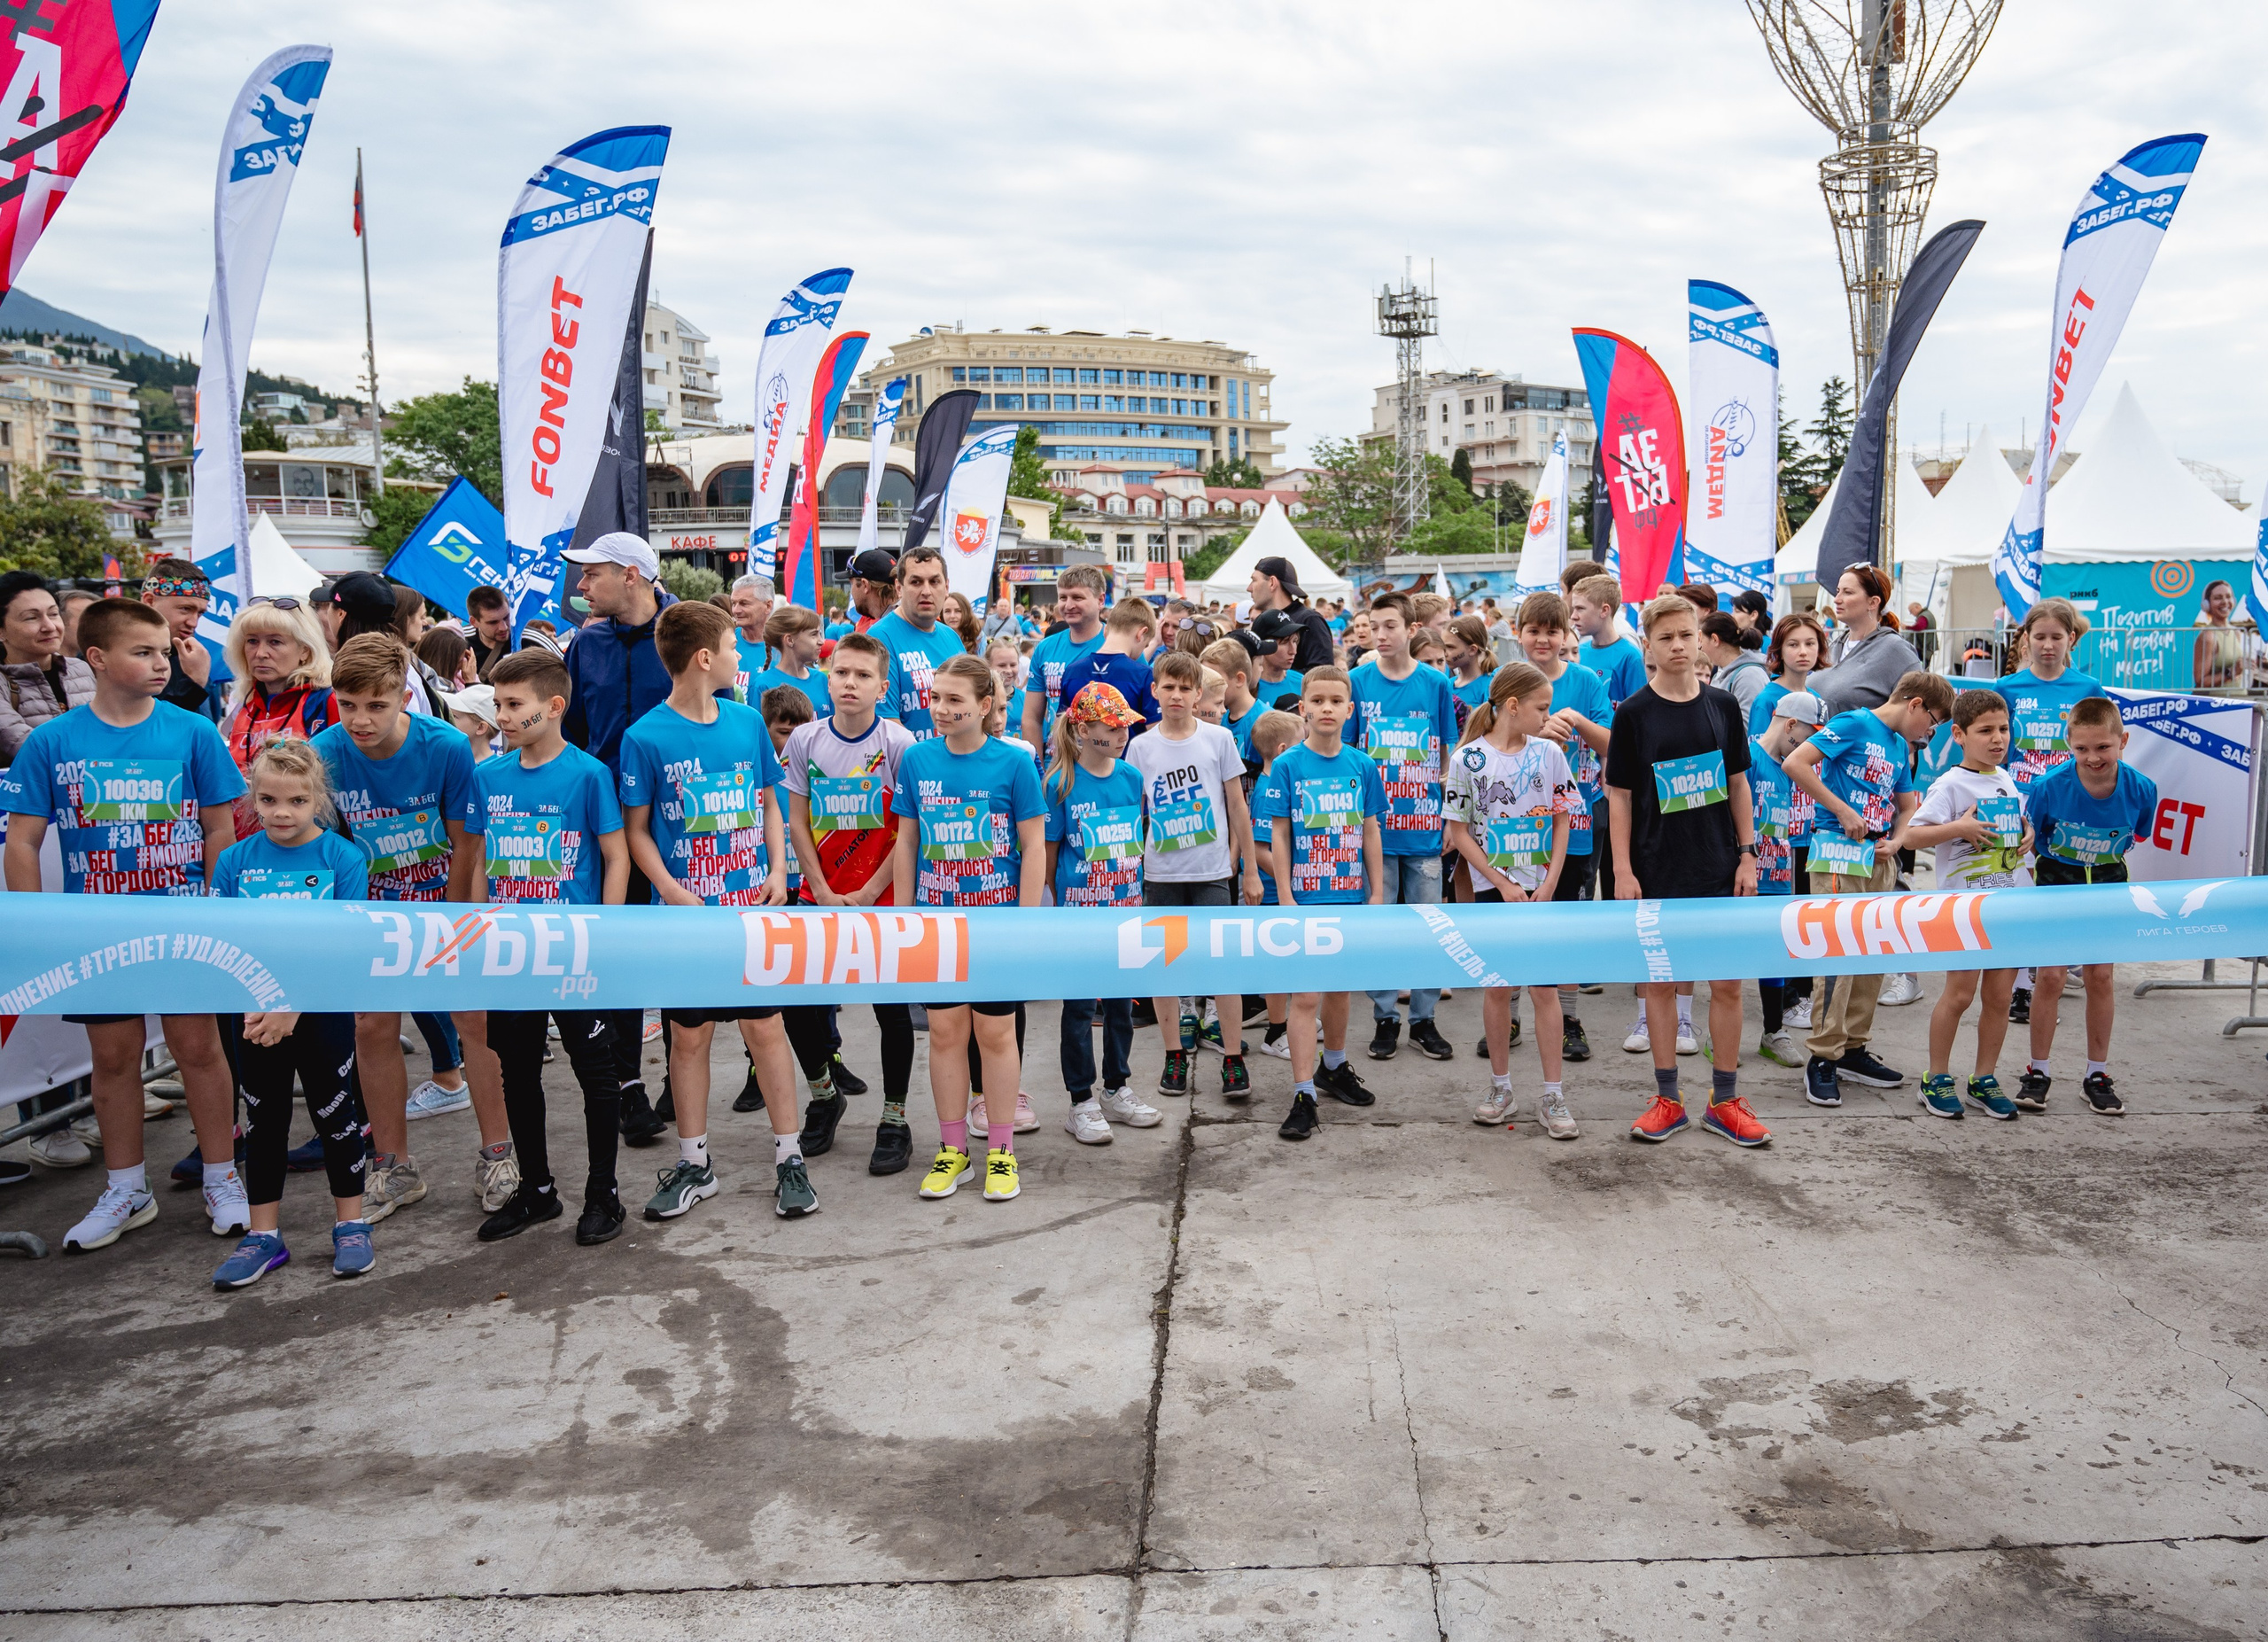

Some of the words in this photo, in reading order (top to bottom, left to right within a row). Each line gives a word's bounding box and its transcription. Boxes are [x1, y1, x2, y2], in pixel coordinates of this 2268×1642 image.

[532, 187, 649, 231] ЗАБЕГ.РФ
[2076, 193, 2173, 234] ЗАБЕГ.РФ
[532, 275, 583, 498] FONBET
[760, 401, 787, 494] МЕДИА
[671, 535, 717, 550] КАФЕ
[898, 650, 932, 672] 2024
[1044, 662, 1065, 676] 2024
[2016, 698, 2038, 709] 2024
[2123, 698, 2188, 721] ЗАБЕГ.РФ
[1380, 730, 1418, 747] 10083
[1820, 727, 1842, 743] ПСБ
[2025, 722, 2062, 737] 10257
[1864, 742, 1886, 759] 2024
[56, 760, 85, 785] 202
[664, 758, 703, 783] 2024
[1166, 765, 1199, 790] ПРО
[103, 779, 164, 801] 10036
[918, 781, 943, 797] 2024
[1671, 770, 1713, 795] 10246
[1755, 780, 1775, 793] 2024
[487, 795, 513, 813] 2024
[702, 789, 745, 813] 10140
[824, 794, 868, 813] 10007
[1317, 792, 1353, 812] 10143
[933, 821, 975, 842] 10172
[1096, 822, 1132, 844] 10255
[1163, 813, 1203, 837] 10070
[375, 829, 428, 855] 10012
[498, 836, 544, 858] 10003
[1503, 832, 1540, 852] 10173
[1821, 843, 1861, 861] 10005
[2070, 835, 2111, 852] 10120
[687, 847, 757, 878] #ГОРДОСТЬ
[1309, 848, 1358, 863] #ГОРДОСТЬ
[932, 858, 995, 877] #ГОРДОСТЬ
[1293, 863, 1336, 877] #ЛЮБОВЬ
[981, 871, 1009, 891] 2024
[1087, 869, 1137, 887] #ГОРДОСТЬ
[1966, 871, 2015, 888] FREE
[495, 880, 559, 899] #ГОРДОСТЬ
[954, 884, 1018, 907] #ЕДИНСТВО
[1066, 886, 1115, 901] #ЛЮБОВЬ
[1780, 891, 1995, 959] СТАРТ
[2137, 927, 2171, 937] ЛИГА
[2176, 923, 2228, 936] ГЕРОЕВ
[1209, 916, 1344, 957] ПСБ
[741, 911, 968, 986] СТАРТ
[1439, 930, 1486, 978] #ЦЕЛЬ
[79, 934, 167, 980] #ТРЕПЕТ
[172, 933, 285, 1010] #УДИВЛЕНИЕ
